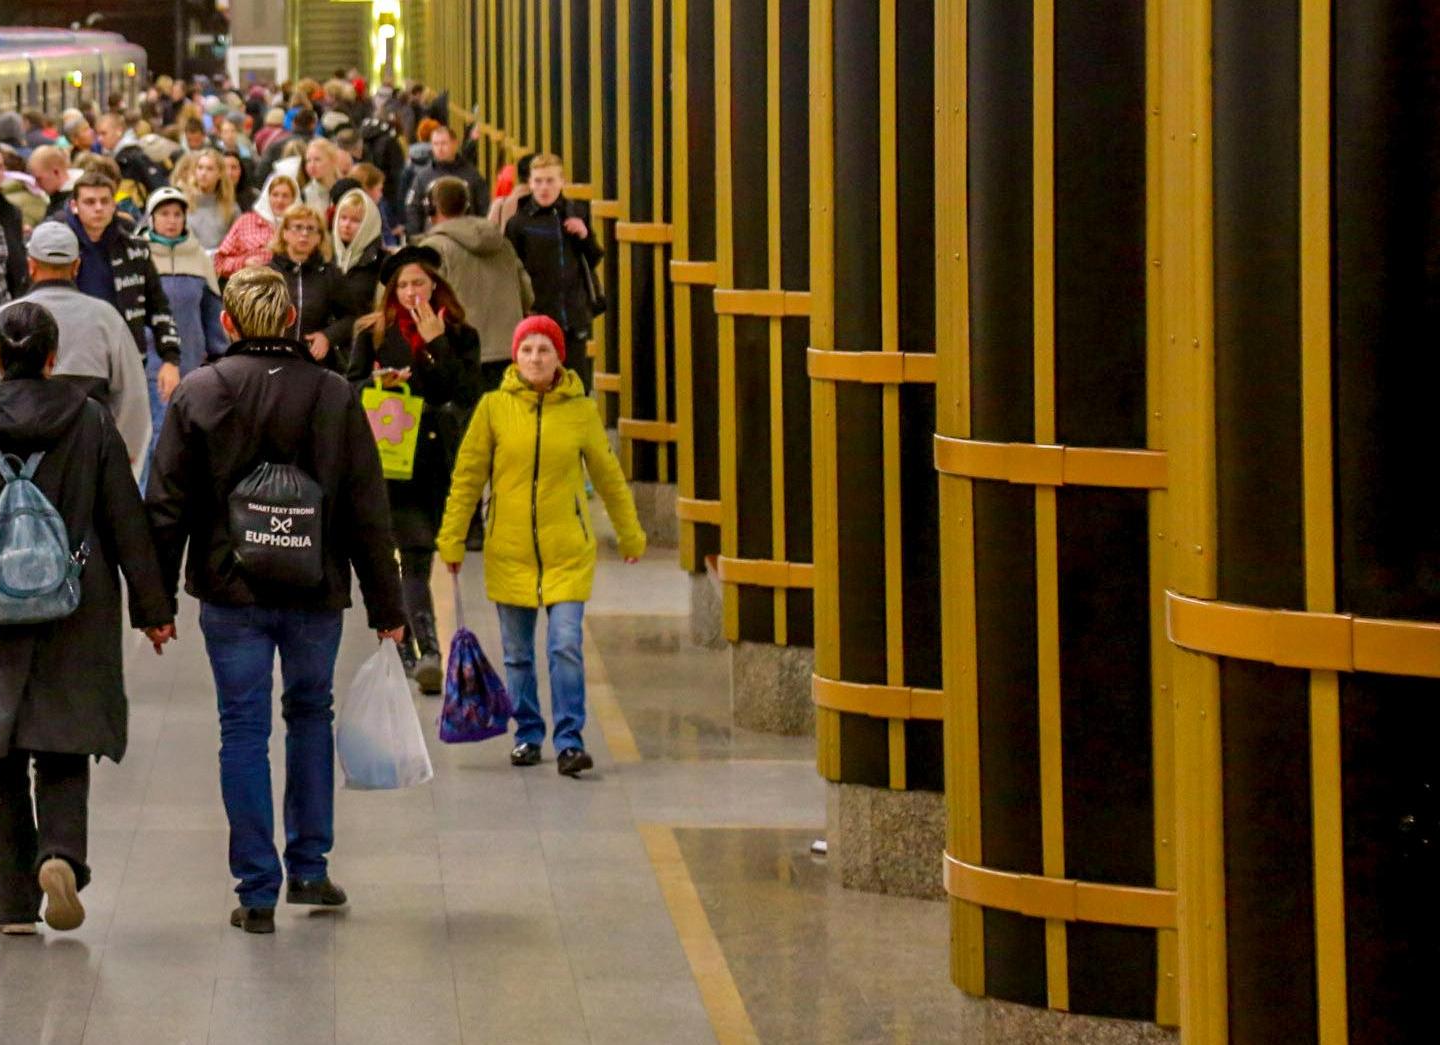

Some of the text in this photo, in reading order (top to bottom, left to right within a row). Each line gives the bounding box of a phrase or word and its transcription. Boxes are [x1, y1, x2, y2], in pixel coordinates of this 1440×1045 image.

[247, 503, 315, 516] SMART SEXY STRONG
[245, 530, 312, 547] EUPHORIA
